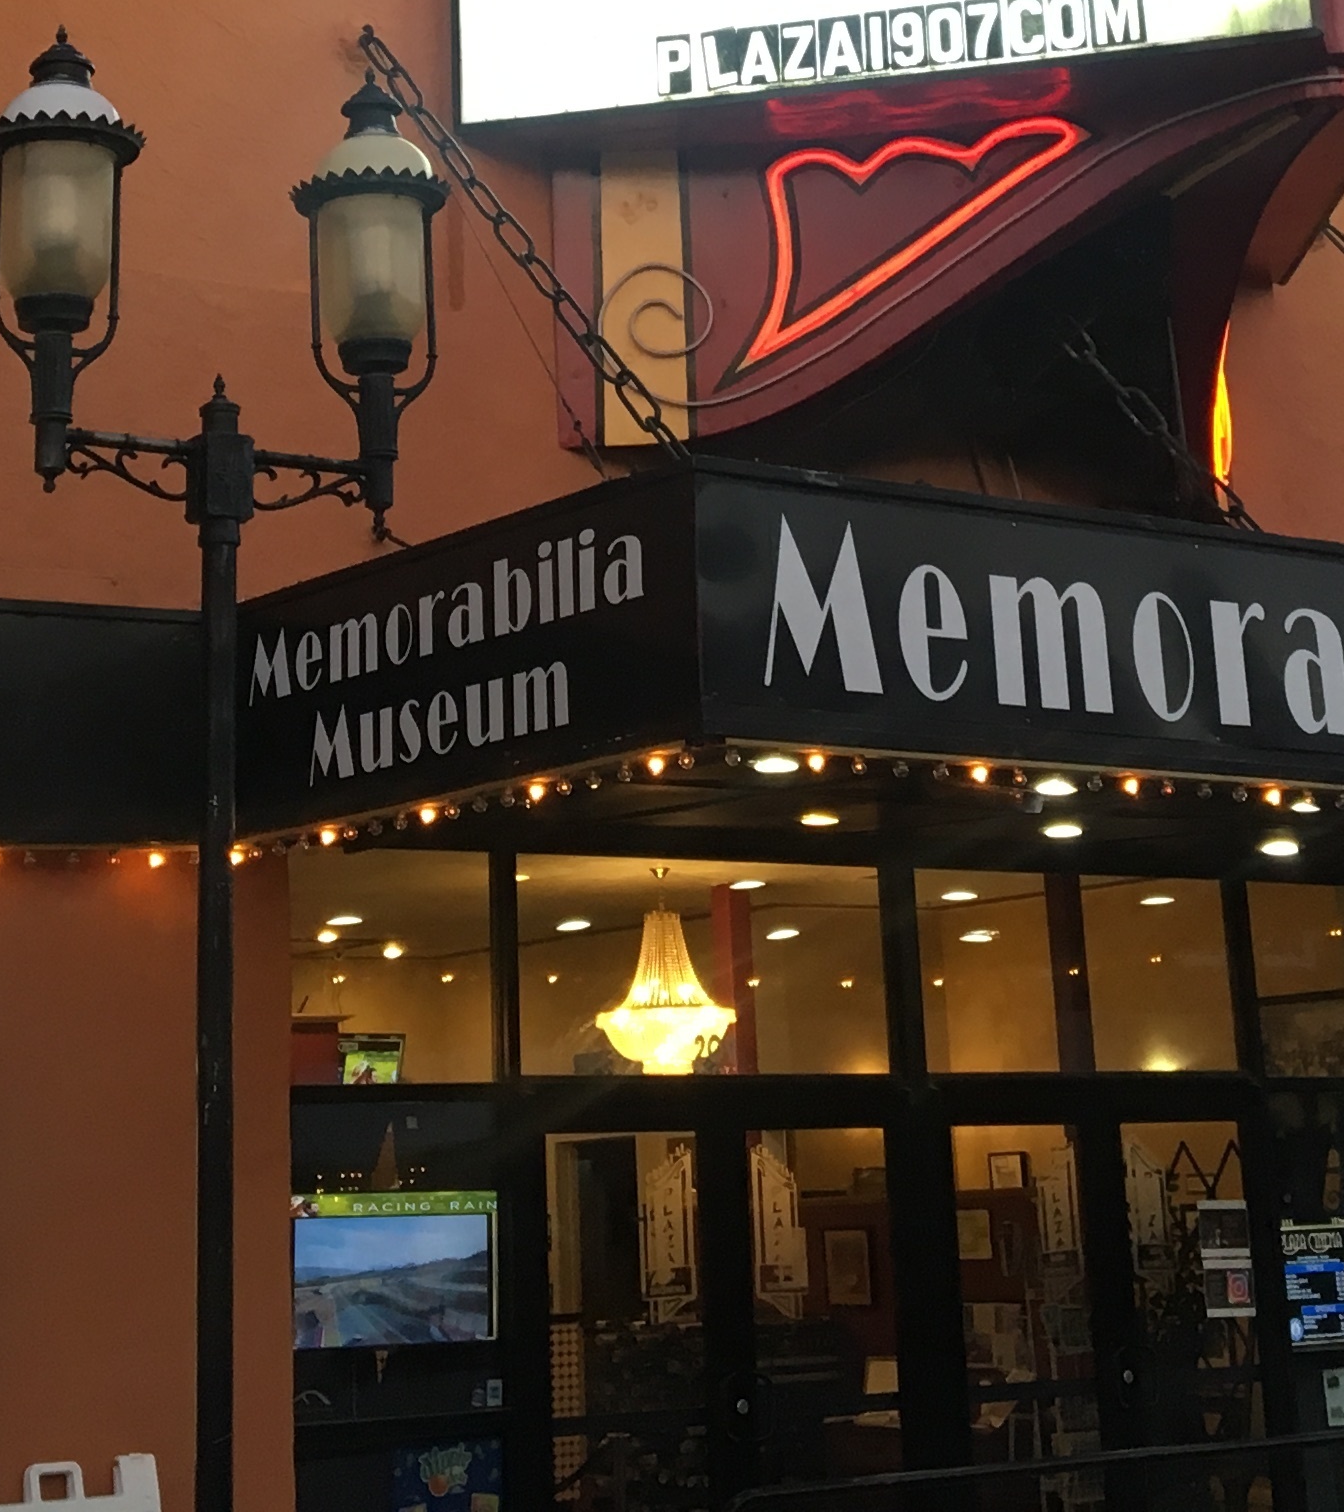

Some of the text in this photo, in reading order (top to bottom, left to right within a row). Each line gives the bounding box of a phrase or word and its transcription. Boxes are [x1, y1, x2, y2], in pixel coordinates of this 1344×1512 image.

[249, 528, 645, 707] Memorabilia
[309, 660, 570, 788] Museum
[352, 1200, 498, 1213] RACING RAIN
